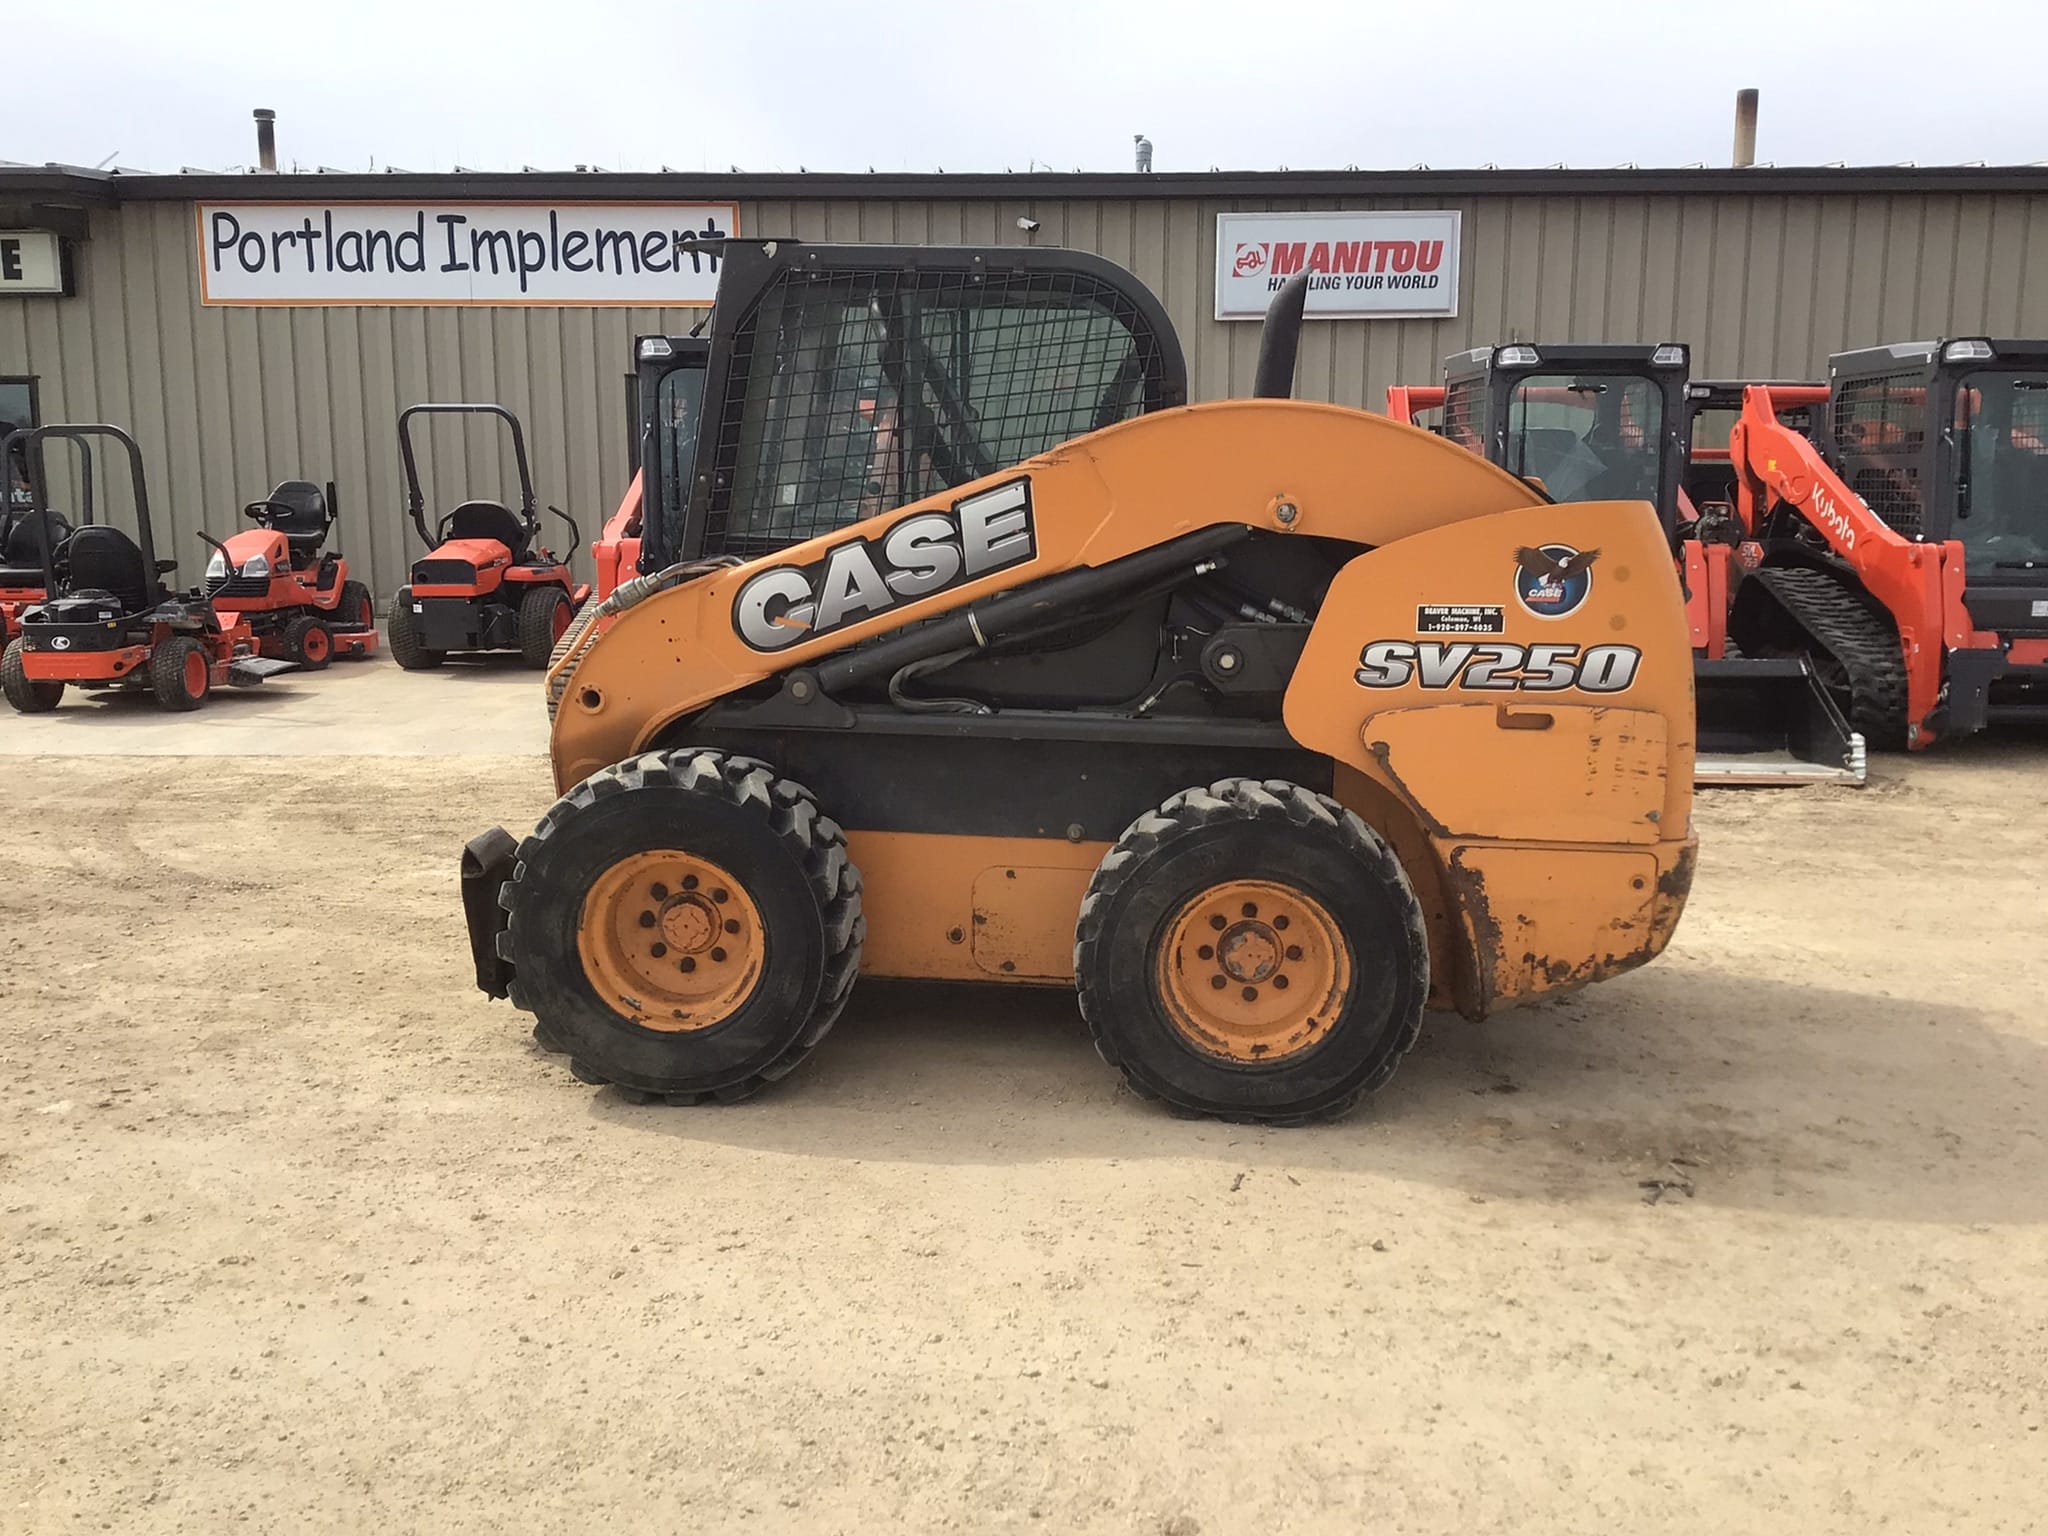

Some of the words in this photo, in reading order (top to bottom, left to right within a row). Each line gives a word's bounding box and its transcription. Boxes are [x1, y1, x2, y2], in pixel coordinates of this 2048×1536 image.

[212, 209, 426, 274] Portland
[436, 208, 726, 293] Implement
[1270, 240, 1444, 275] MANITOU
[1267, 275, 1342, 292] HALING
[1345, 274, 1384, 291] YOUR
[1387, 274, 1439, 290] WORLD
[1811, 481, 1856, 551] Kubota
[733, 476, 1036, 651] CASE
[1424, 607, 1449, 615] BEAVER
[1484, 607, 1499, 616] INC.
[1353, 638, 1643, 693] SV250
